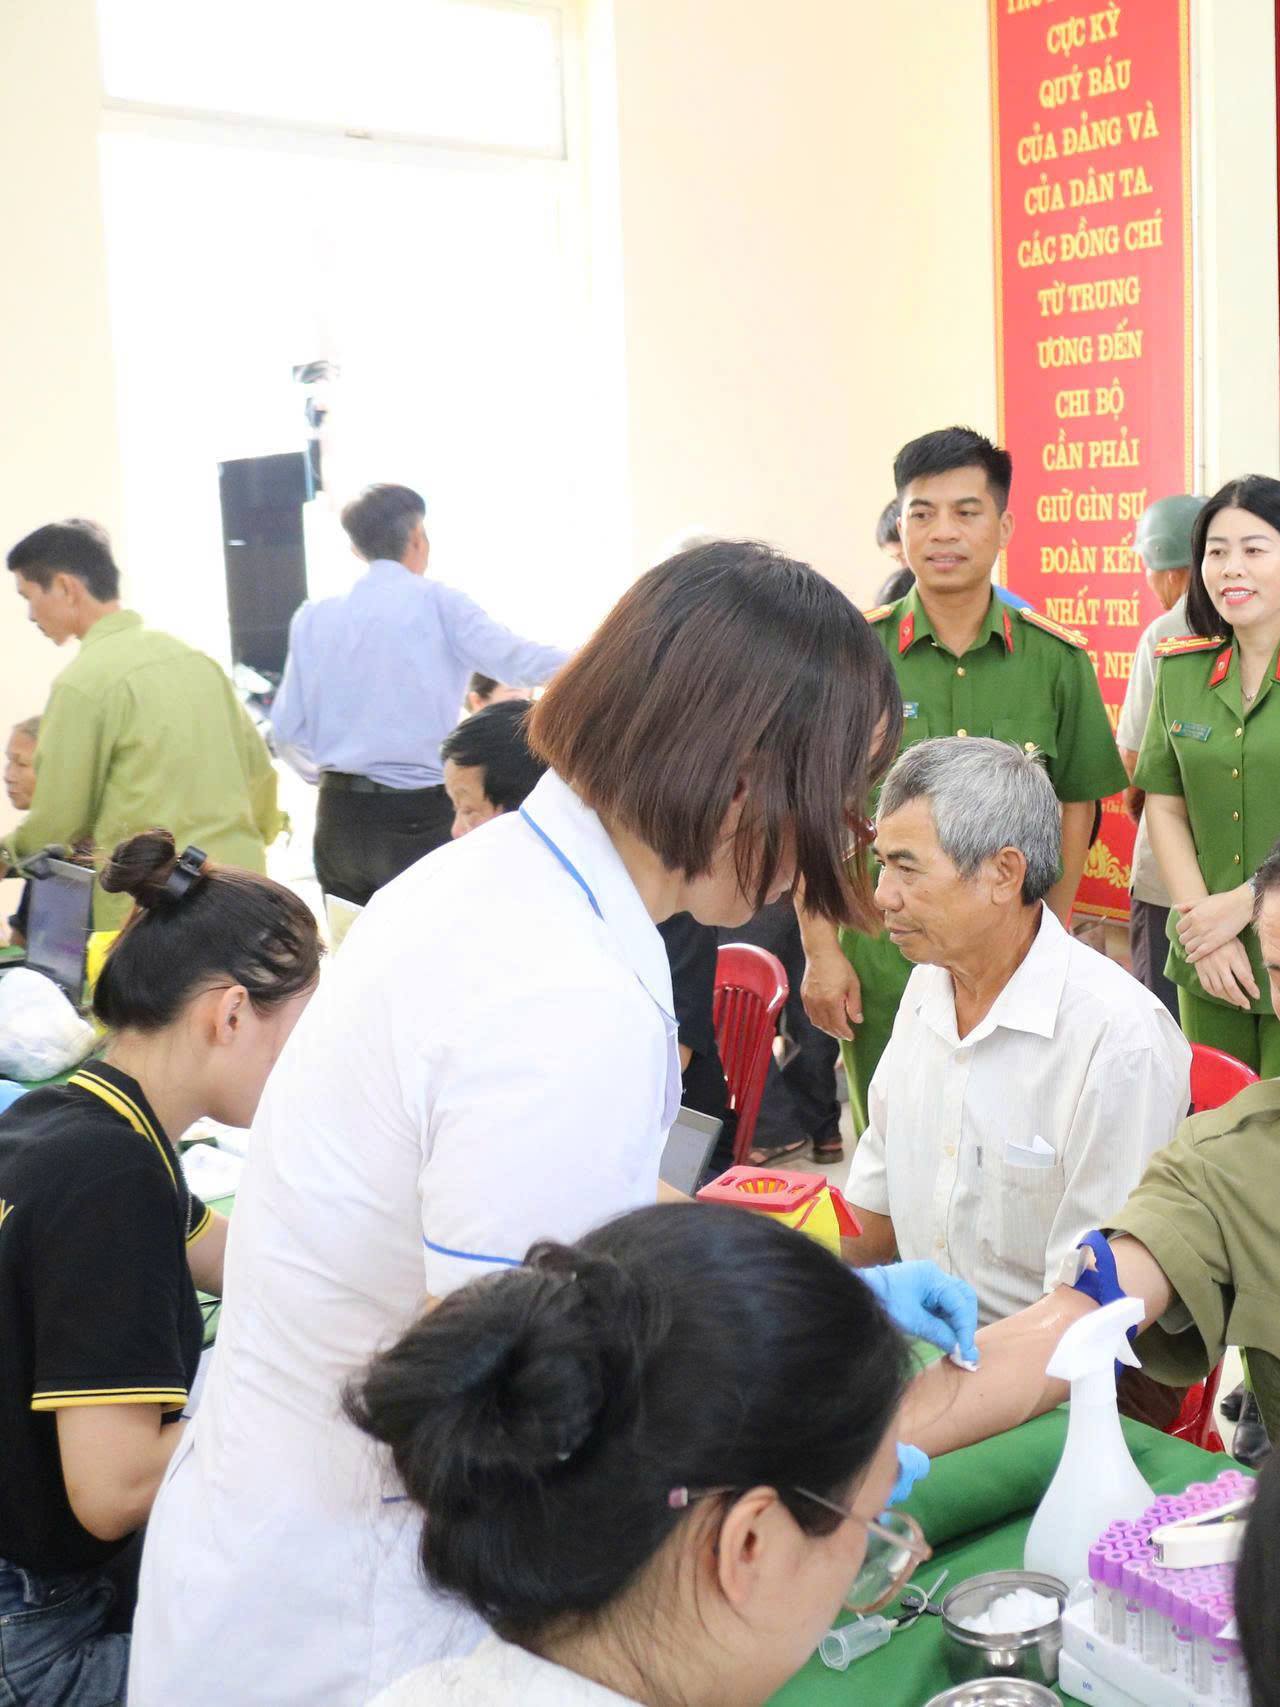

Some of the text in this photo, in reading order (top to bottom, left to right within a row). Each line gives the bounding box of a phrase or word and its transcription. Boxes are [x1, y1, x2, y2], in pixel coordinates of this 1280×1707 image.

[1047, 3, 1121, 57] CỰC KỲ
[1039, 55, 1131, 109] QUÝ BÁU
[1017, 100, 1159, 165] CỦA ĐẢNG VÀ
[1024, 165, 1153, 216] CỦA DÂN TA.
[1017, 208, 1163, 268] CÁC ĐỒNG CHÍ
[1037, 276, 1141, 317] TỪ TRUNG
[1037, 316, 1143, 368] ƯƠNG ĐẾN
[1056, 376, 1125, 421] CHI BỘ
[1042, 426, 1139, 471] CẦN PHẢI
[1036, 488, 1073, 522] GIỮ
[1076, 486, 1113, 522] GÌN
[1041, 532, 1141, 574] ĐOÀN KẾT
[1045, 584, 1139, 627] NHẤT TRÍ
